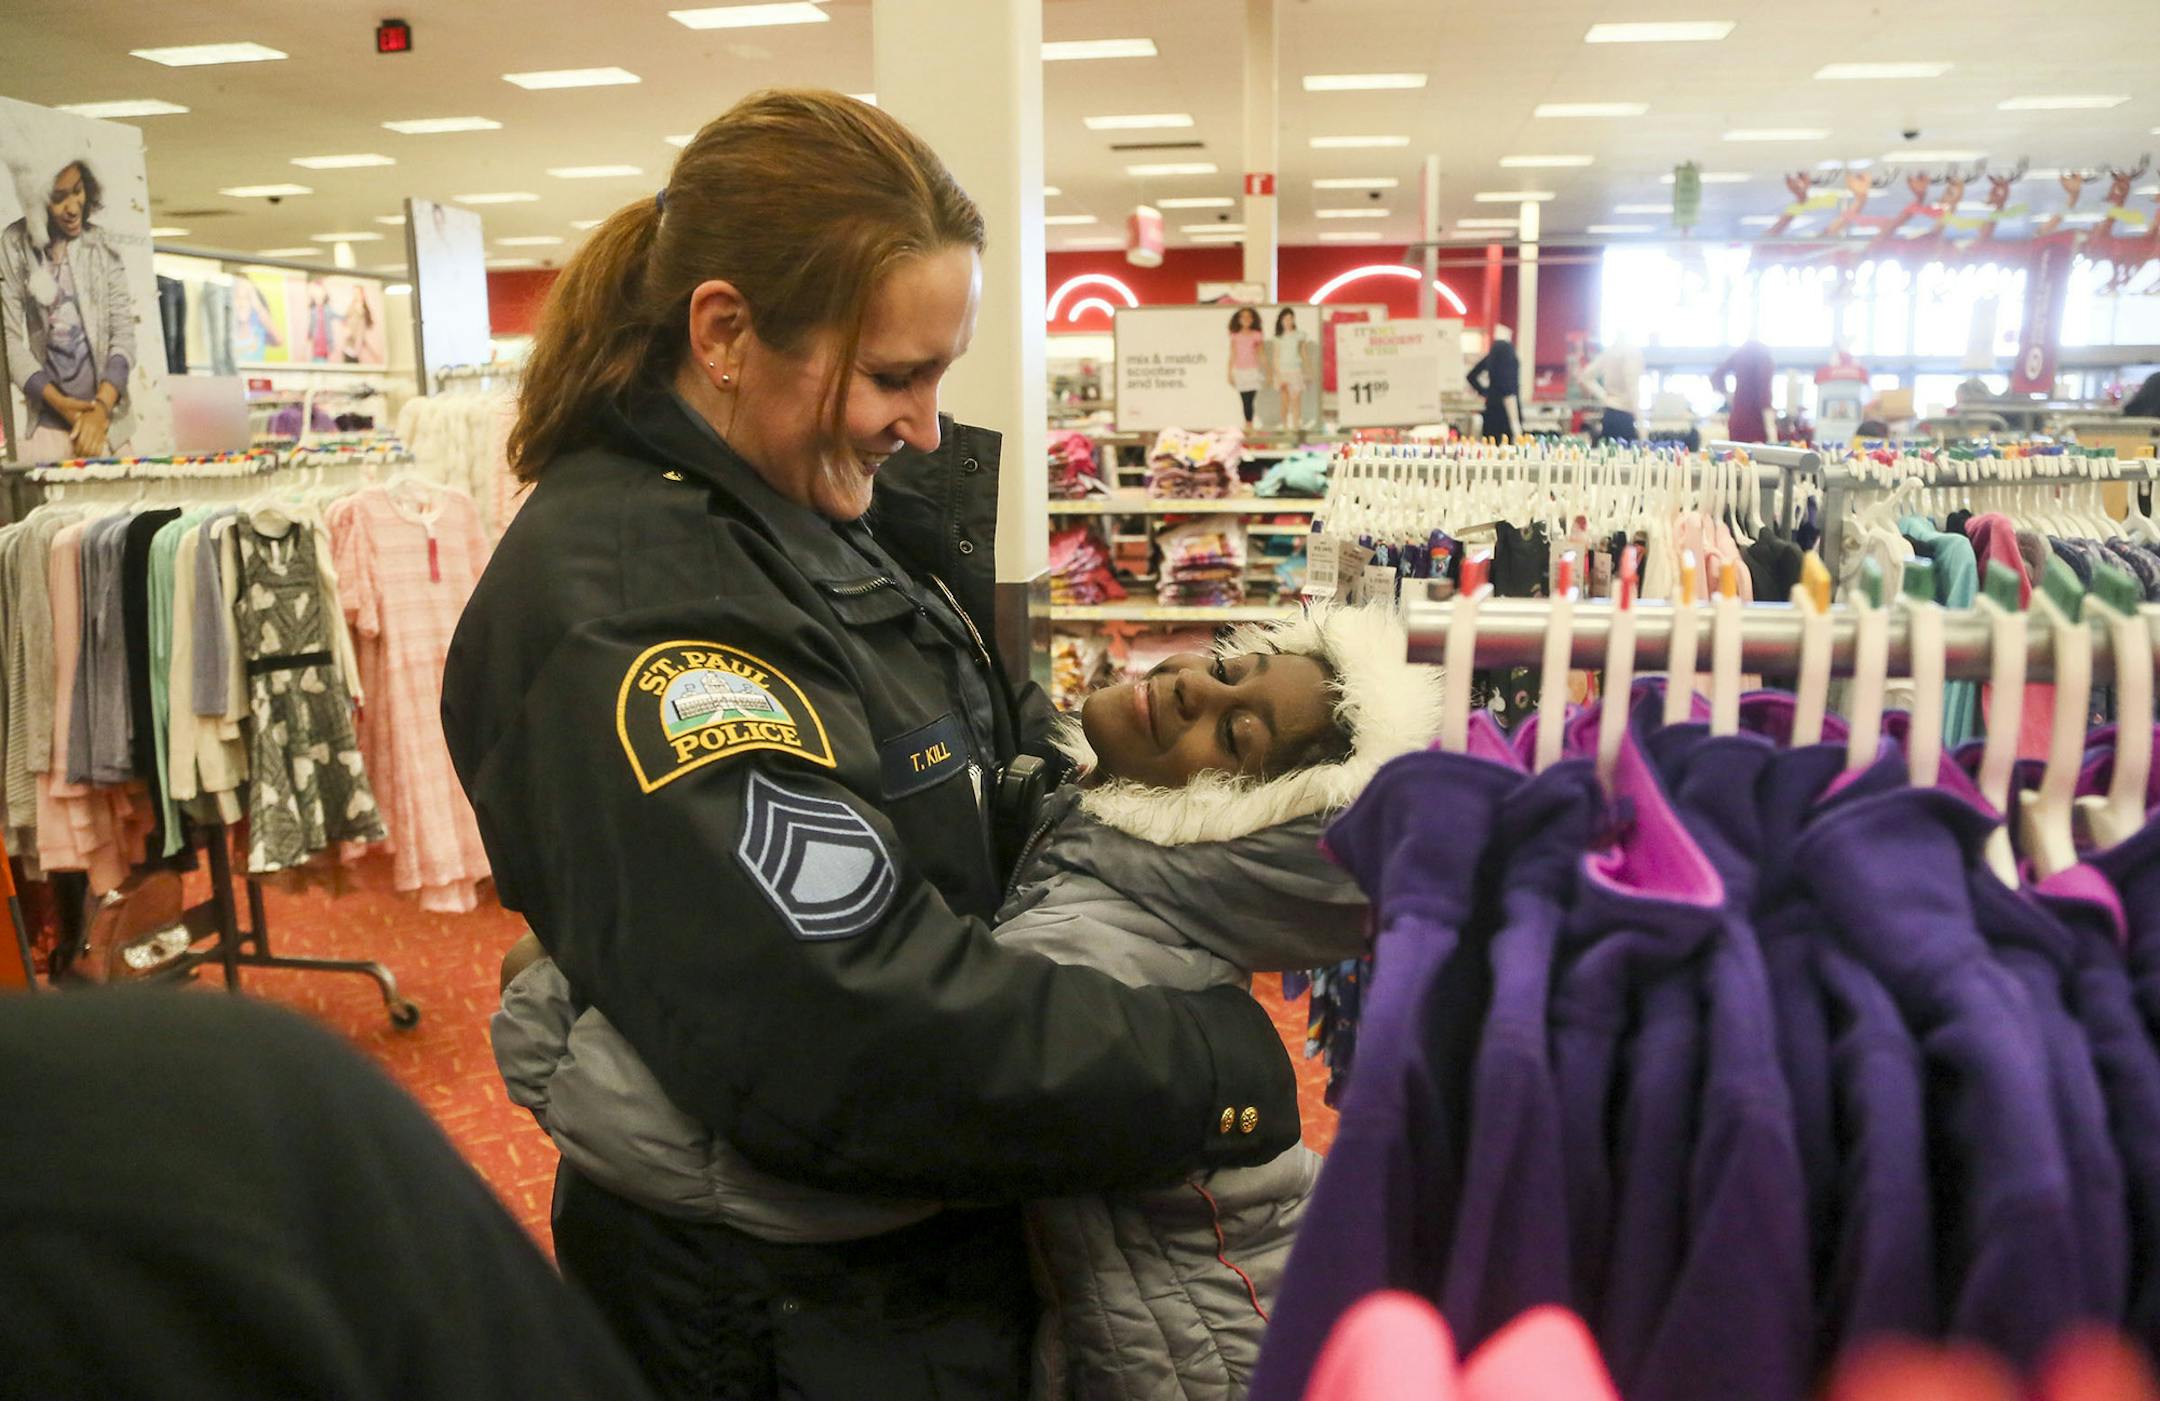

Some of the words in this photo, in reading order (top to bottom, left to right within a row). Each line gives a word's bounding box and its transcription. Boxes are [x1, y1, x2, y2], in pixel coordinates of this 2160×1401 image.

[1125, 355, 1150, 365] mix
[1152, 353, 1162, 365] &
[1164, 353, 1208, 365] match
[1126, 367, 1187, 377] scooters
[1127, 379, 1153, 389] and
[638, 657, 686, 696] ST.
[680, 651, 771, 689] PAUL
[670, 722, 802, 764] POLICE
[910, 752, 926, 772] T.
[925, 741, 952, 768] KILL
